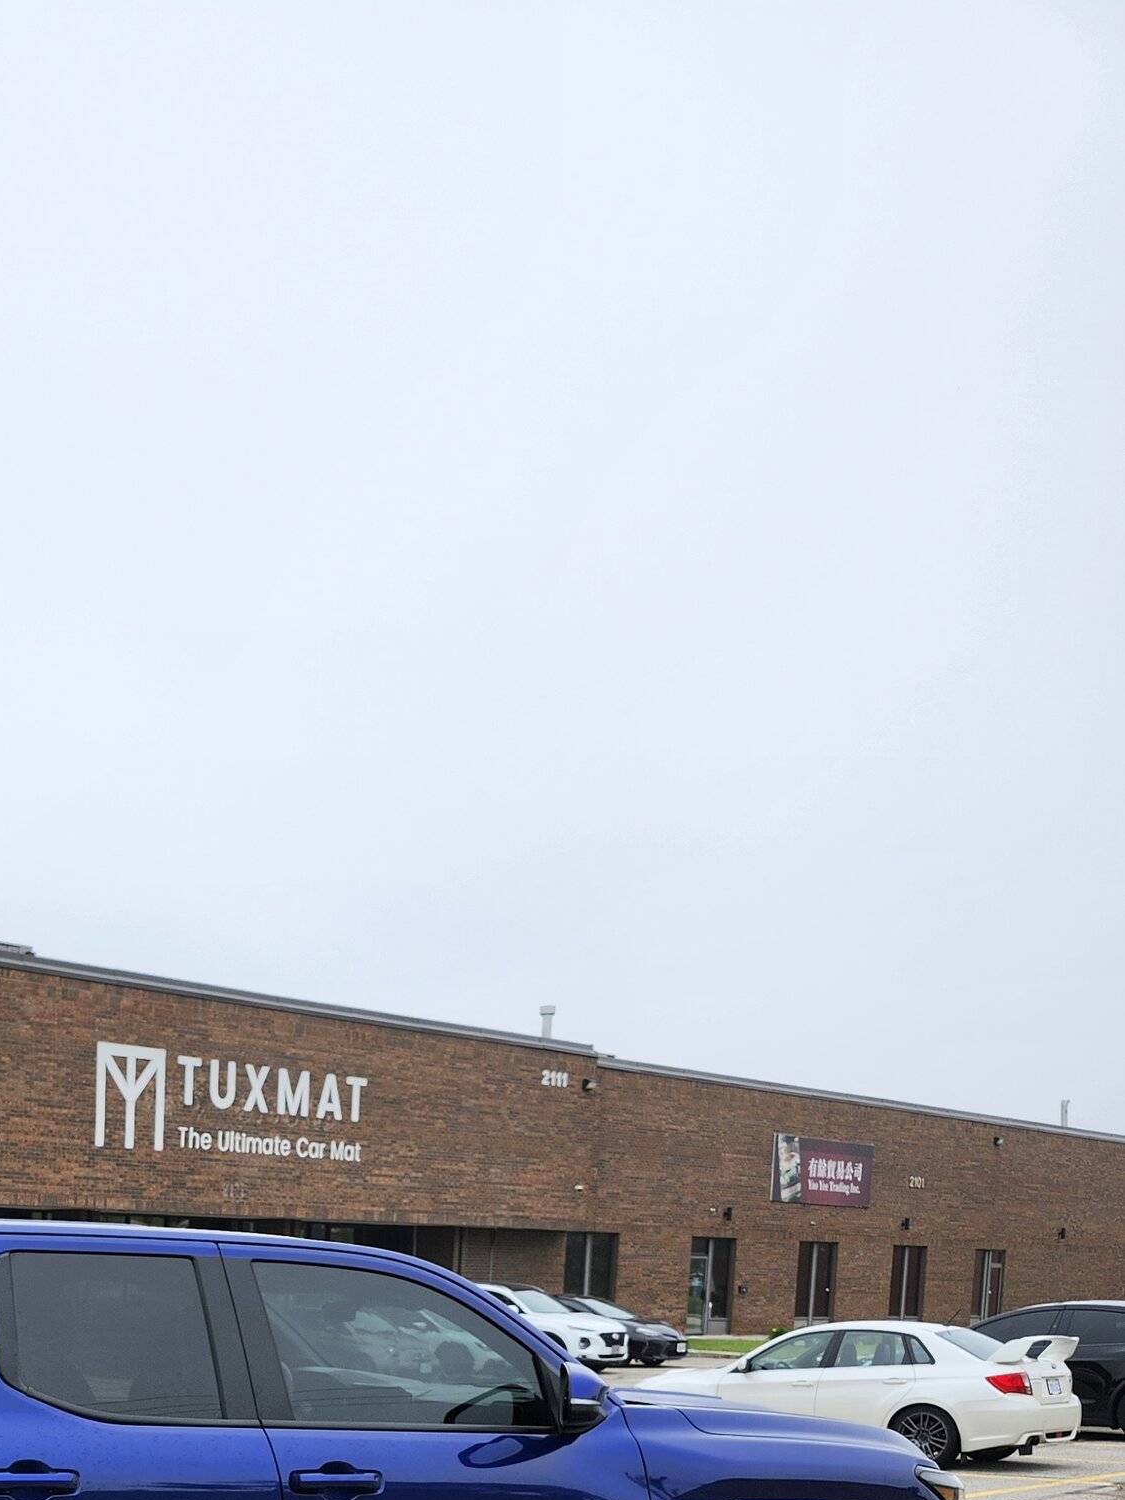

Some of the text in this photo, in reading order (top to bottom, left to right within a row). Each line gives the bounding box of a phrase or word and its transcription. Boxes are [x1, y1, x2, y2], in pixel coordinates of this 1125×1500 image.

[177, 1055, 369, 1123] TUXMAT
[541, 1069, 569, 1088] 2111
[177, 1126, 362, 1163] The Ultimate Car Mat
[829, 1180, 850, 1196] Trading
